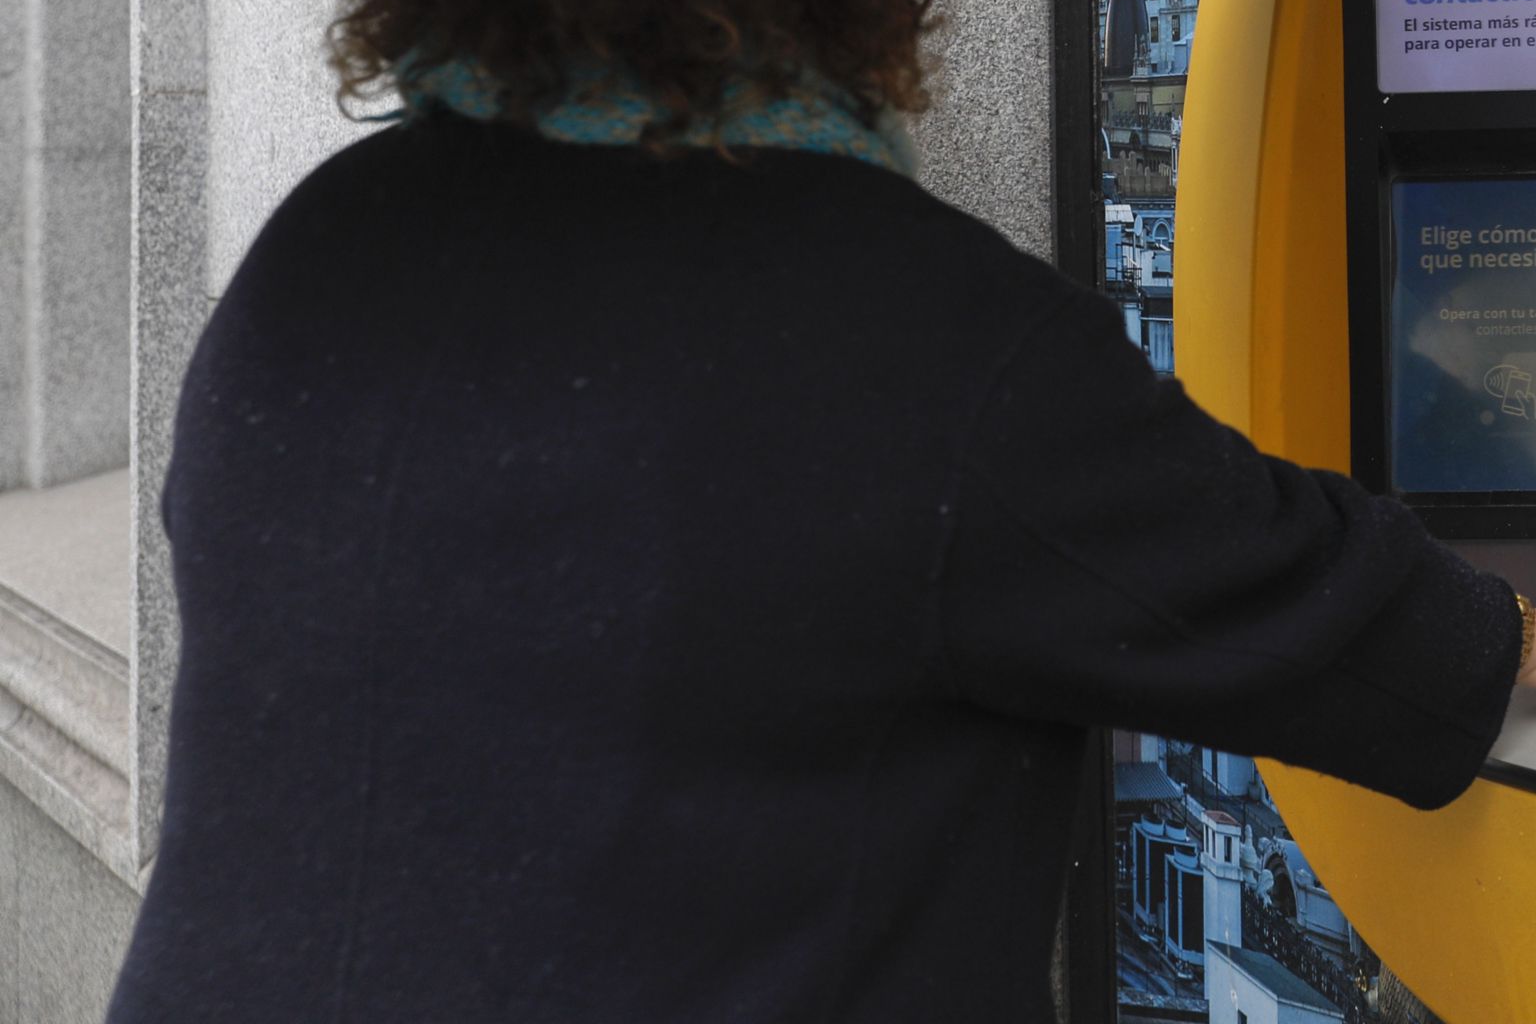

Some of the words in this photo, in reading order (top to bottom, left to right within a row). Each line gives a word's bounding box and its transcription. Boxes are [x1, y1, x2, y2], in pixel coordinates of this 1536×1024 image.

[1404, 18, 1418, 32] El
[1422, 16, 1483, 31] sistema
[1487, 13, 1519, 30] más
[1404, 37, 1441, 53] para
[1445, 35, 1497, 51] operar
[1502, 34, 1522, 47] en
[1421, 226, 1472, 250] Elige
[1420, 253, 1462, 274] que
[1440, 308, 1480, 322] Opera
[1483, 308, 1507, 319] con
[1511, 308, 1525, 319] tu
